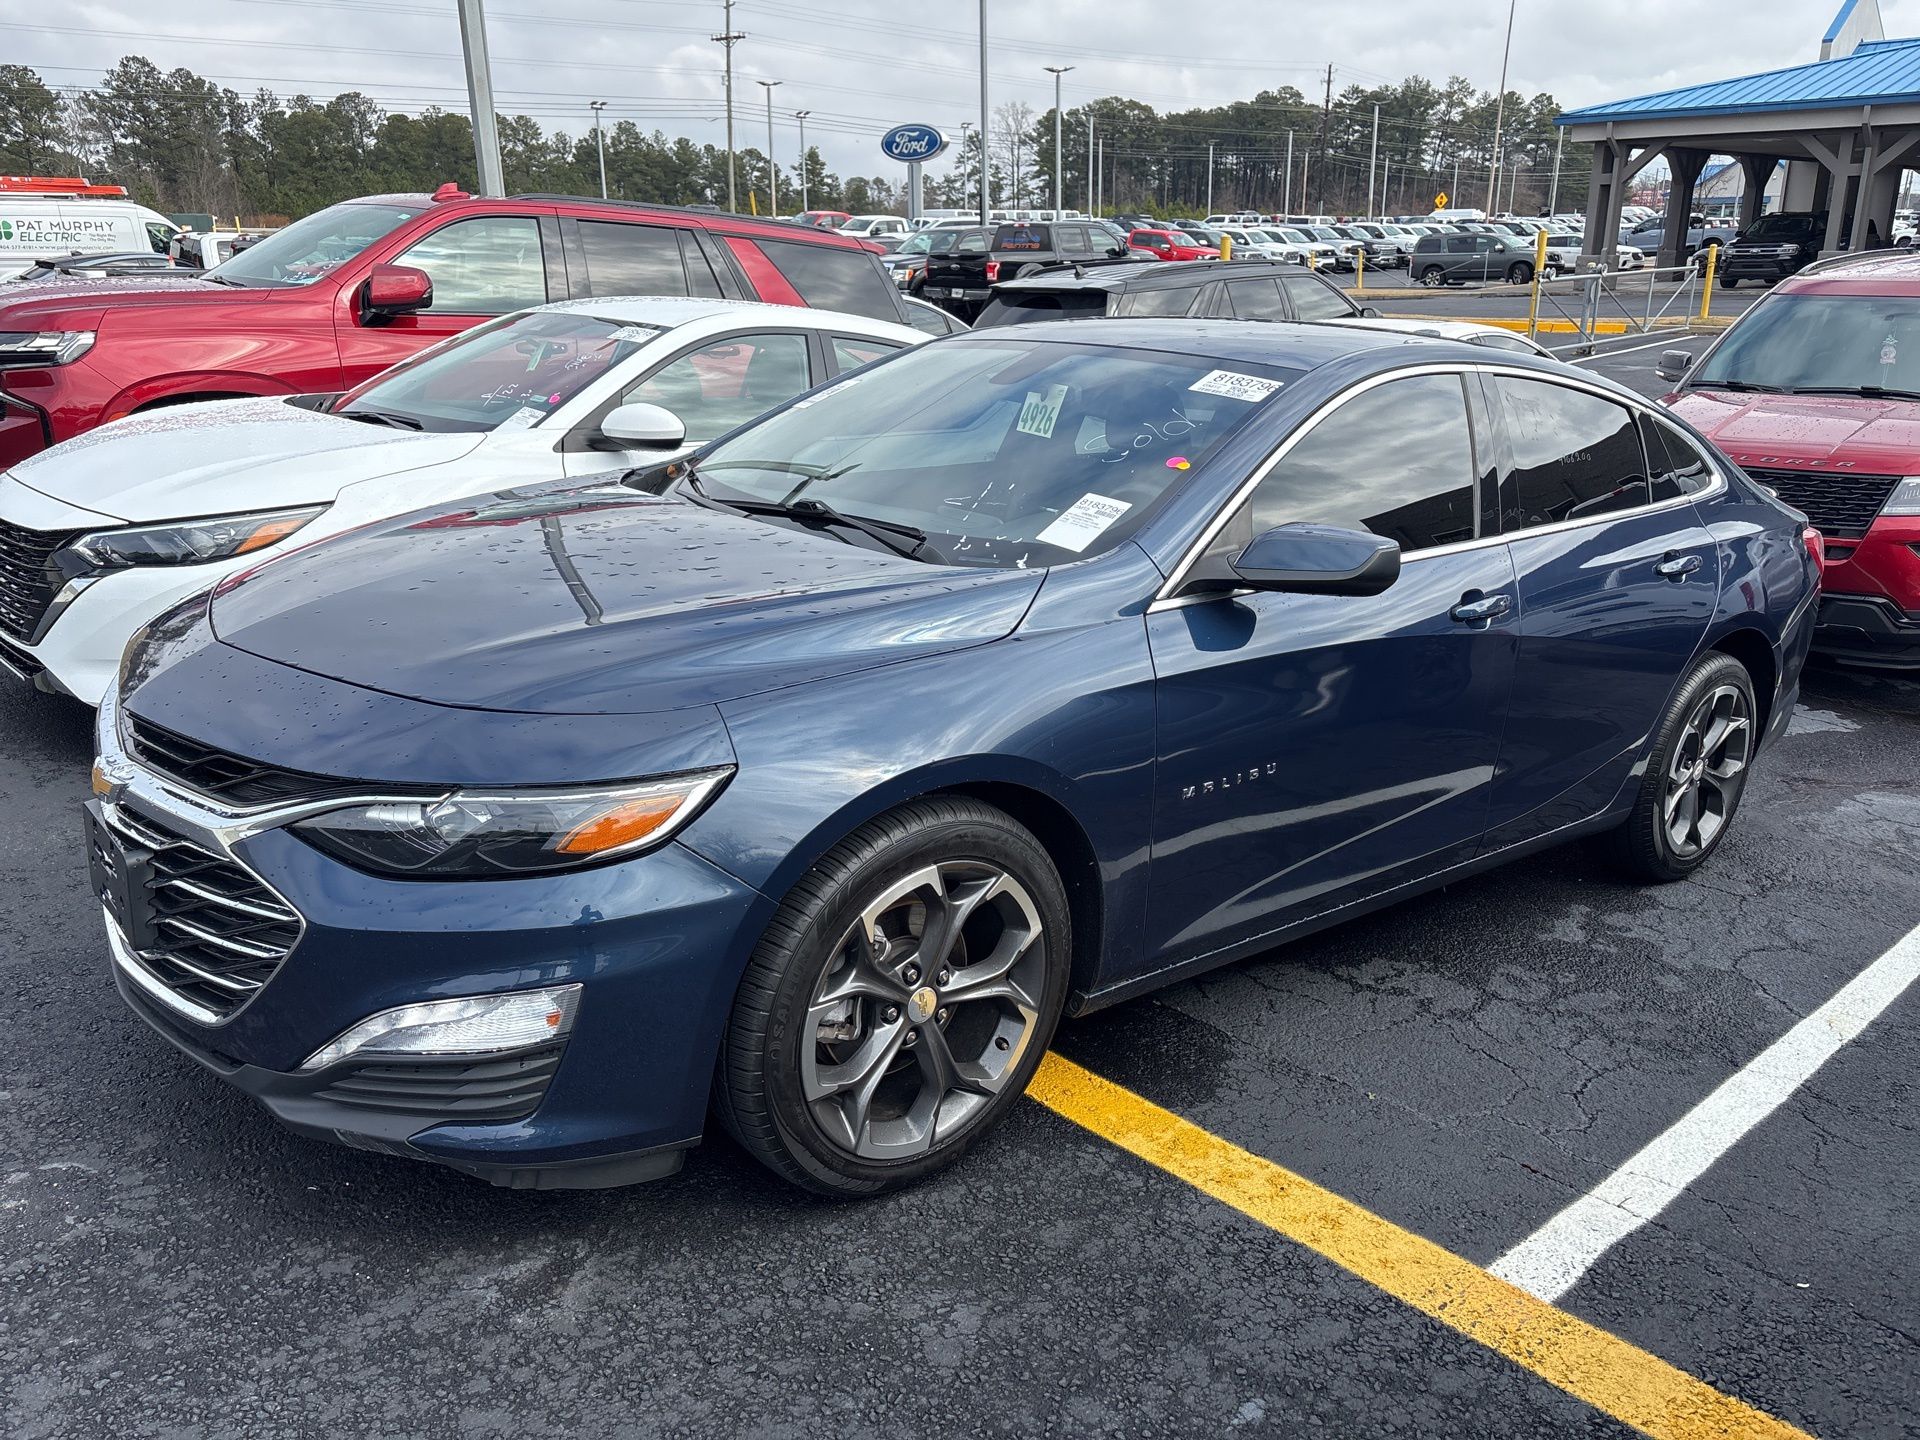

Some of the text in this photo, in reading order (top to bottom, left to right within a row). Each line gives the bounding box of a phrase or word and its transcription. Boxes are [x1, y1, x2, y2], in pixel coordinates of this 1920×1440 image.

[892, 131, 930, 154] Ford
[16, 220, 114, 232] PAT MURPHY
[20, 231, 82, 242] ELECTRIC
[1213, 373, 1280, 393] 8183796
[1020, 402, 1056, 435] 4926
[1080, 498, 1125, 515] 8183796
[1182, 762, 1277, 800] MALIBU
